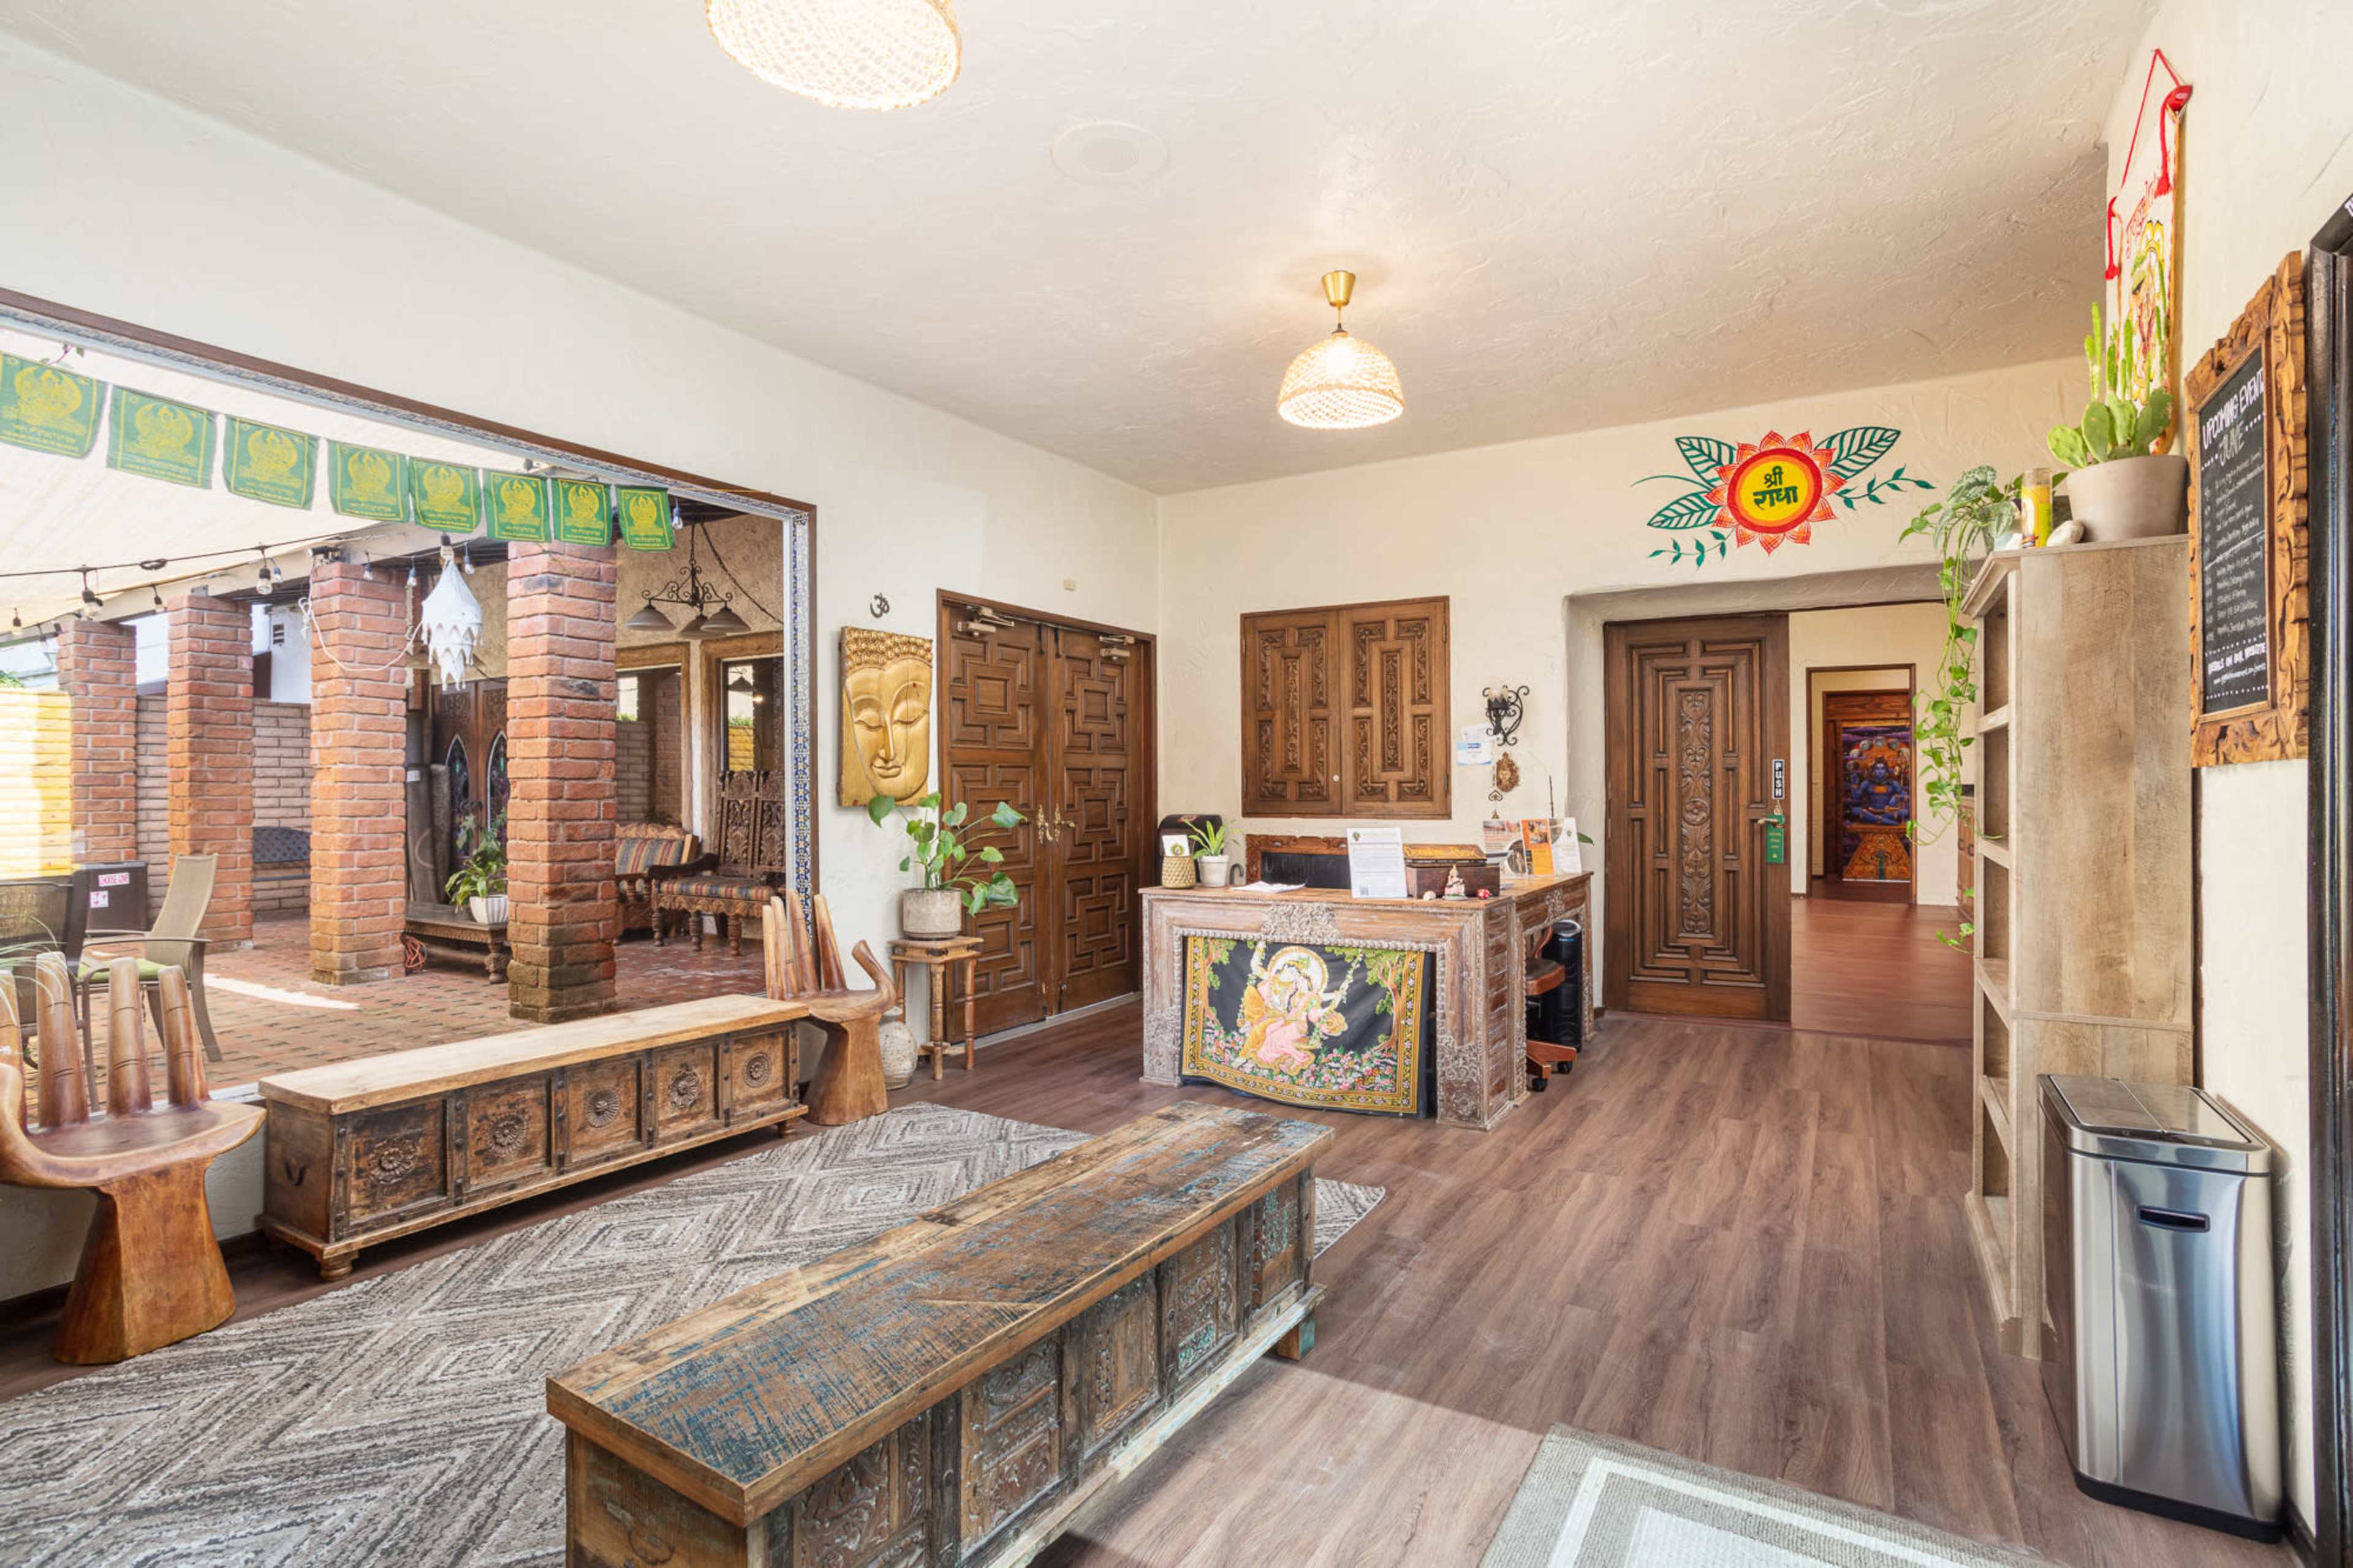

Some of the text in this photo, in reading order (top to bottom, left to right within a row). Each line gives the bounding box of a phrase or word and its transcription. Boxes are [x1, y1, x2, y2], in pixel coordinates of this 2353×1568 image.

[2202, 393, 2238, 450] UPCOMING
[2219, 420, 2245, 467] JUNE
[1764, 466, 1784, 488] श्री
[1753, 485, 1798, 510] राधा
